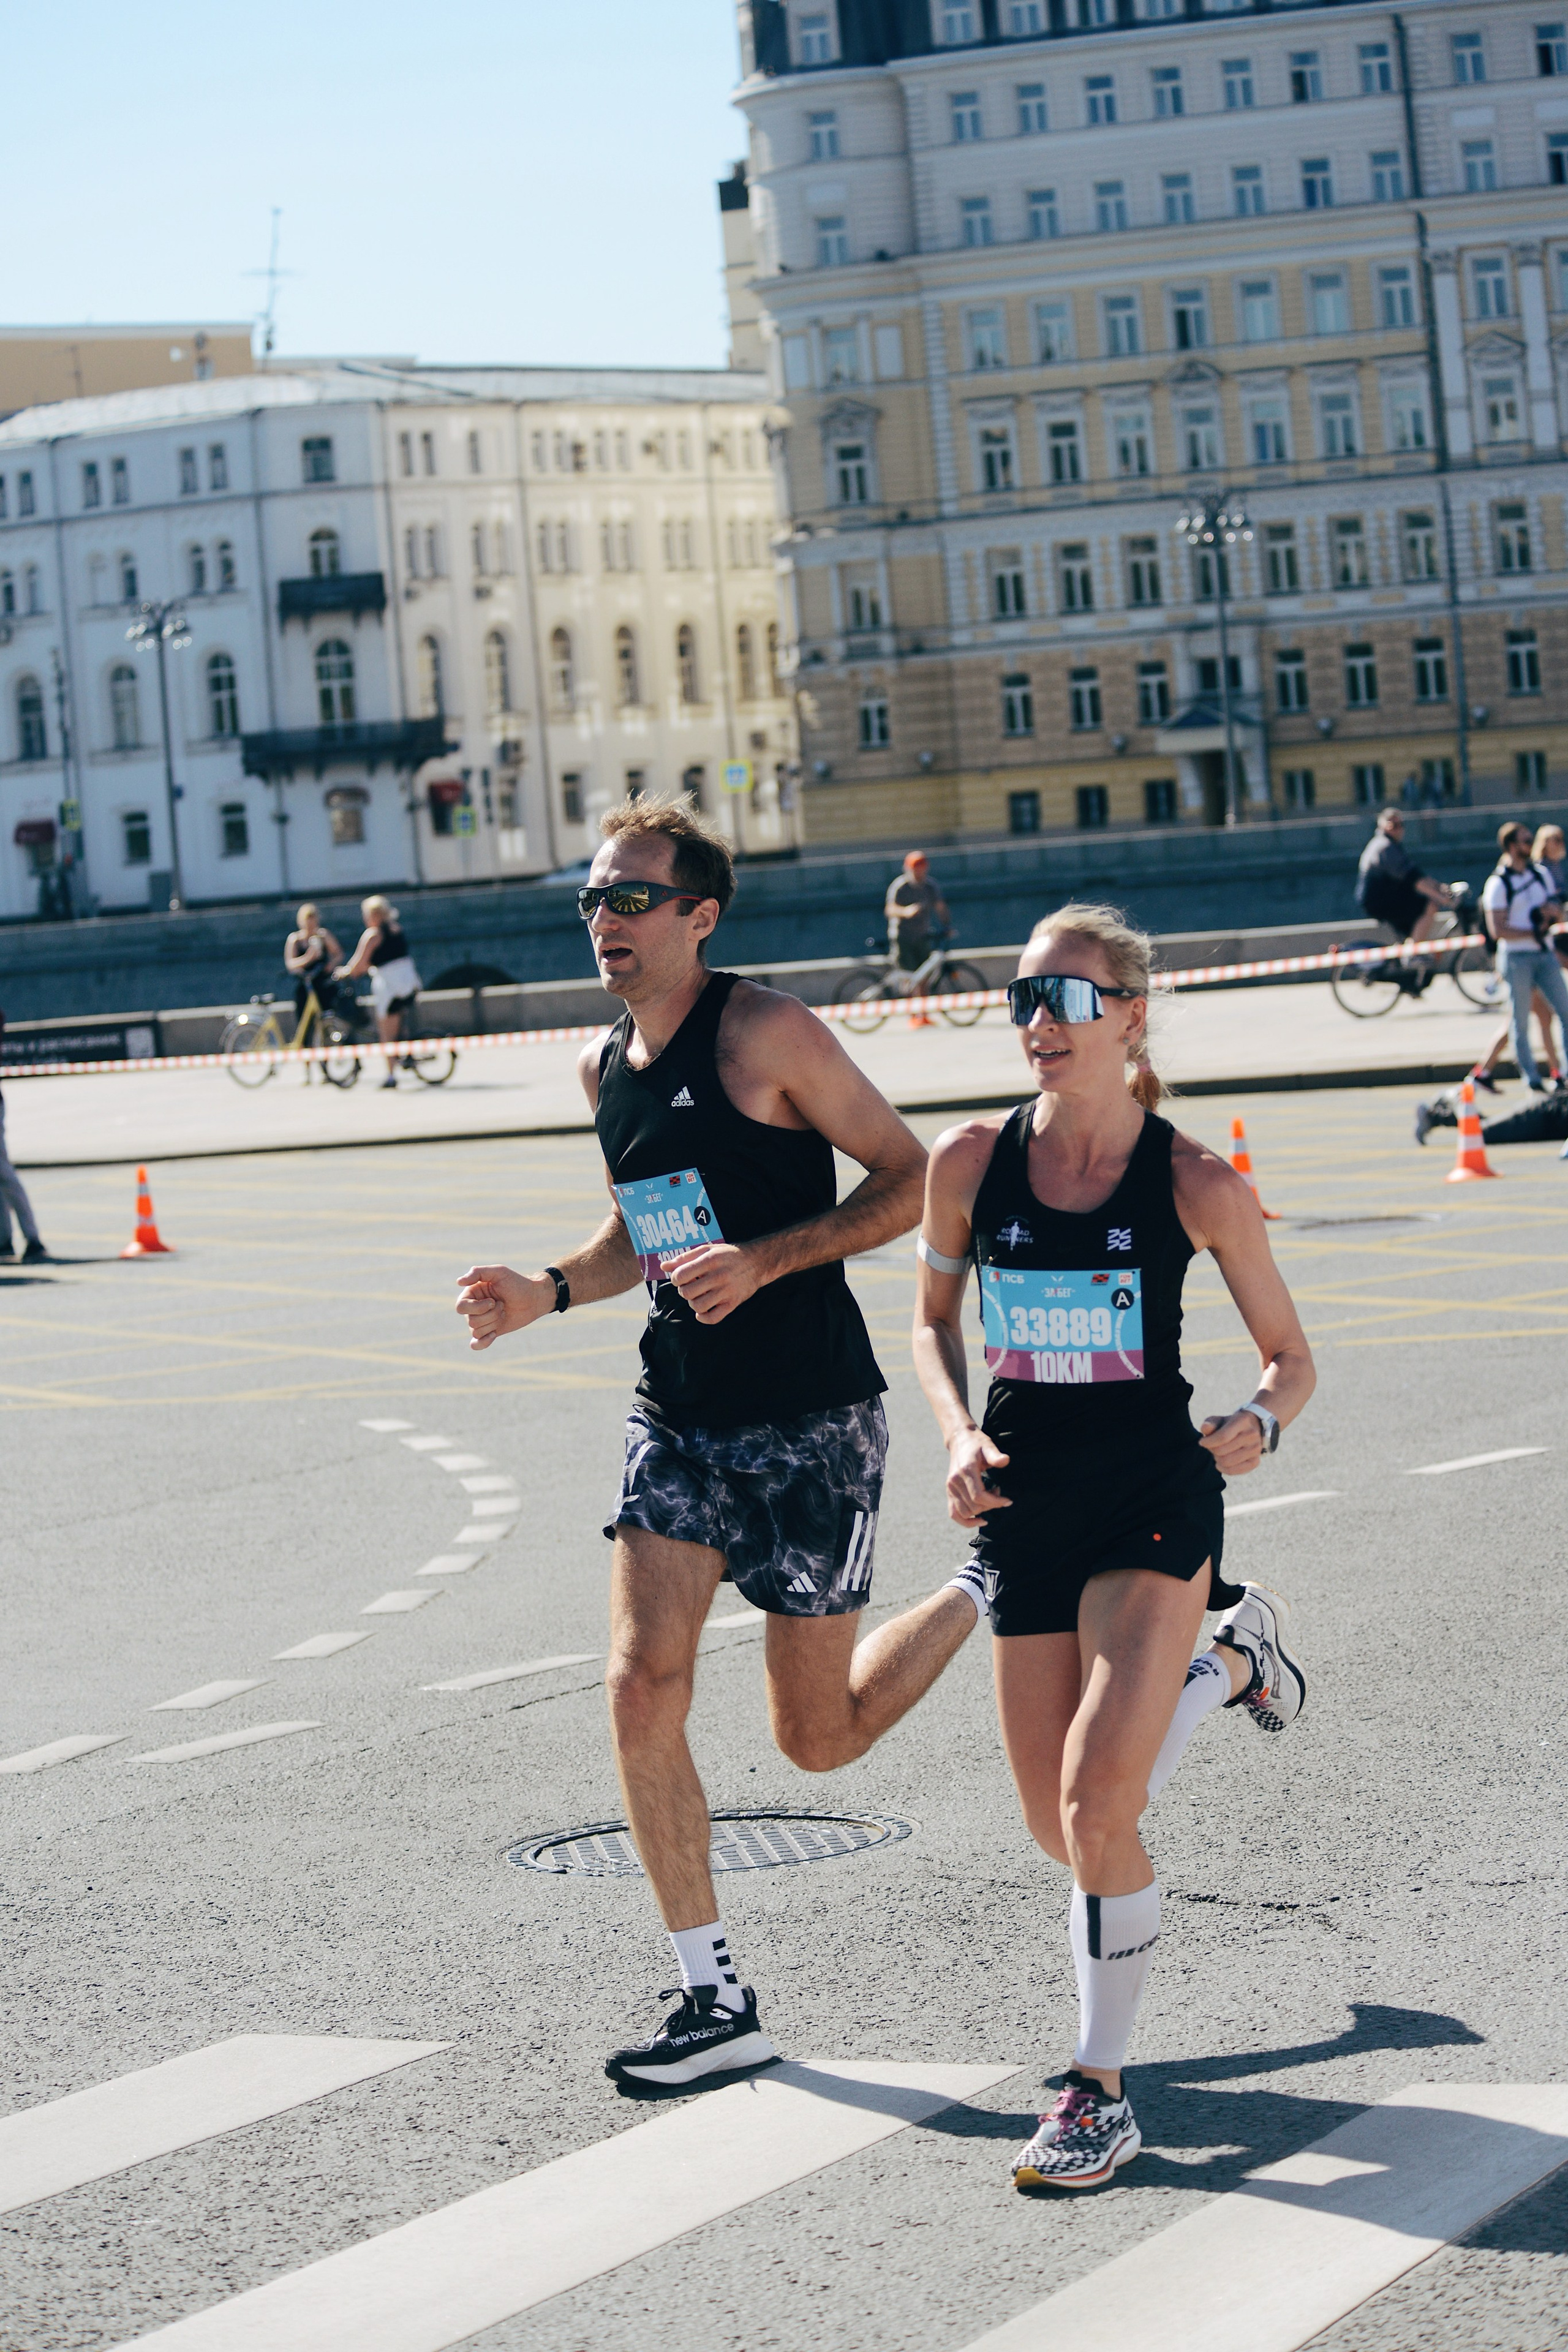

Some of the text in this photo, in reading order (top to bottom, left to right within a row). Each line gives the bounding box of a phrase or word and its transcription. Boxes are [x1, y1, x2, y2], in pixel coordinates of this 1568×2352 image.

[624, 1187, 635, 1196] ПСБ
[697, 1210, 707, 1224] A
[636, 1205, 699, 1249] 30464
[1002, 1273, 1025, 1284] ПСБ
[1115, 1291, 1130, 1306] A
[1009, 1306, 1112, 1347] 33889
[669, 2023, 734, 2047] new balance
